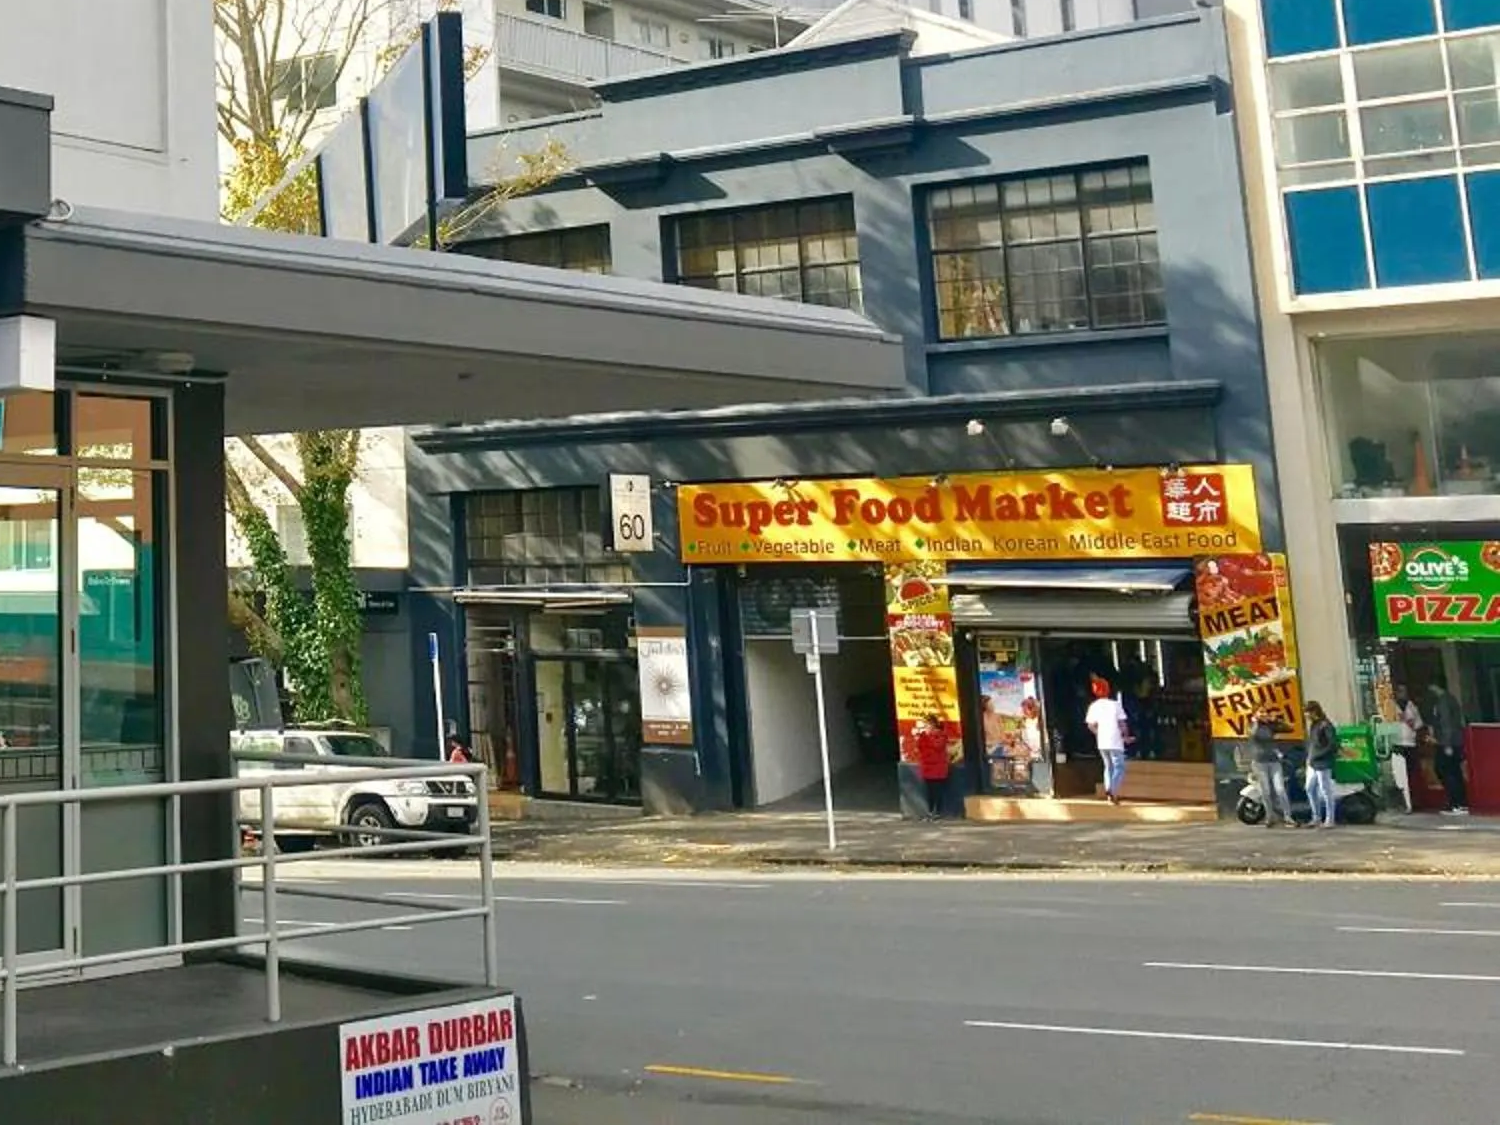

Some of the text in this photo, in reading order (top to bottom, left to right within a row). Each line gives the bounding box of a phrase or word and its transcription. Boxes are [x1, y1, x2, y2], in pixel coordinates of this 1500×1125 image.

[619, 514, 645, 540] 60
[692, 481, 1134, 536] Super Food Market
[697, 539, 732, 556] Fruit
[753, 538, 835, 559] Vegetable
[858, 537, 902, 554] Meat
[926, 535, 983, 553] Indian
[993, 535, 1059, 552] Korean
[1186, 530, 1237, 549] Food
[1405, 555, 1469, 576] OLIVE'S
[1203, 596, 1279, 636] MEAT
[1212, 679, 1293, 718] FRUIT
[345, 1008, 514, 1072] AKBAR DURBAR
[355, 1046, 506, 1100] INDIAN TAKE AWAY
[350, 1074, 516, 1125] HYDERABADI DUM BIRYANI
